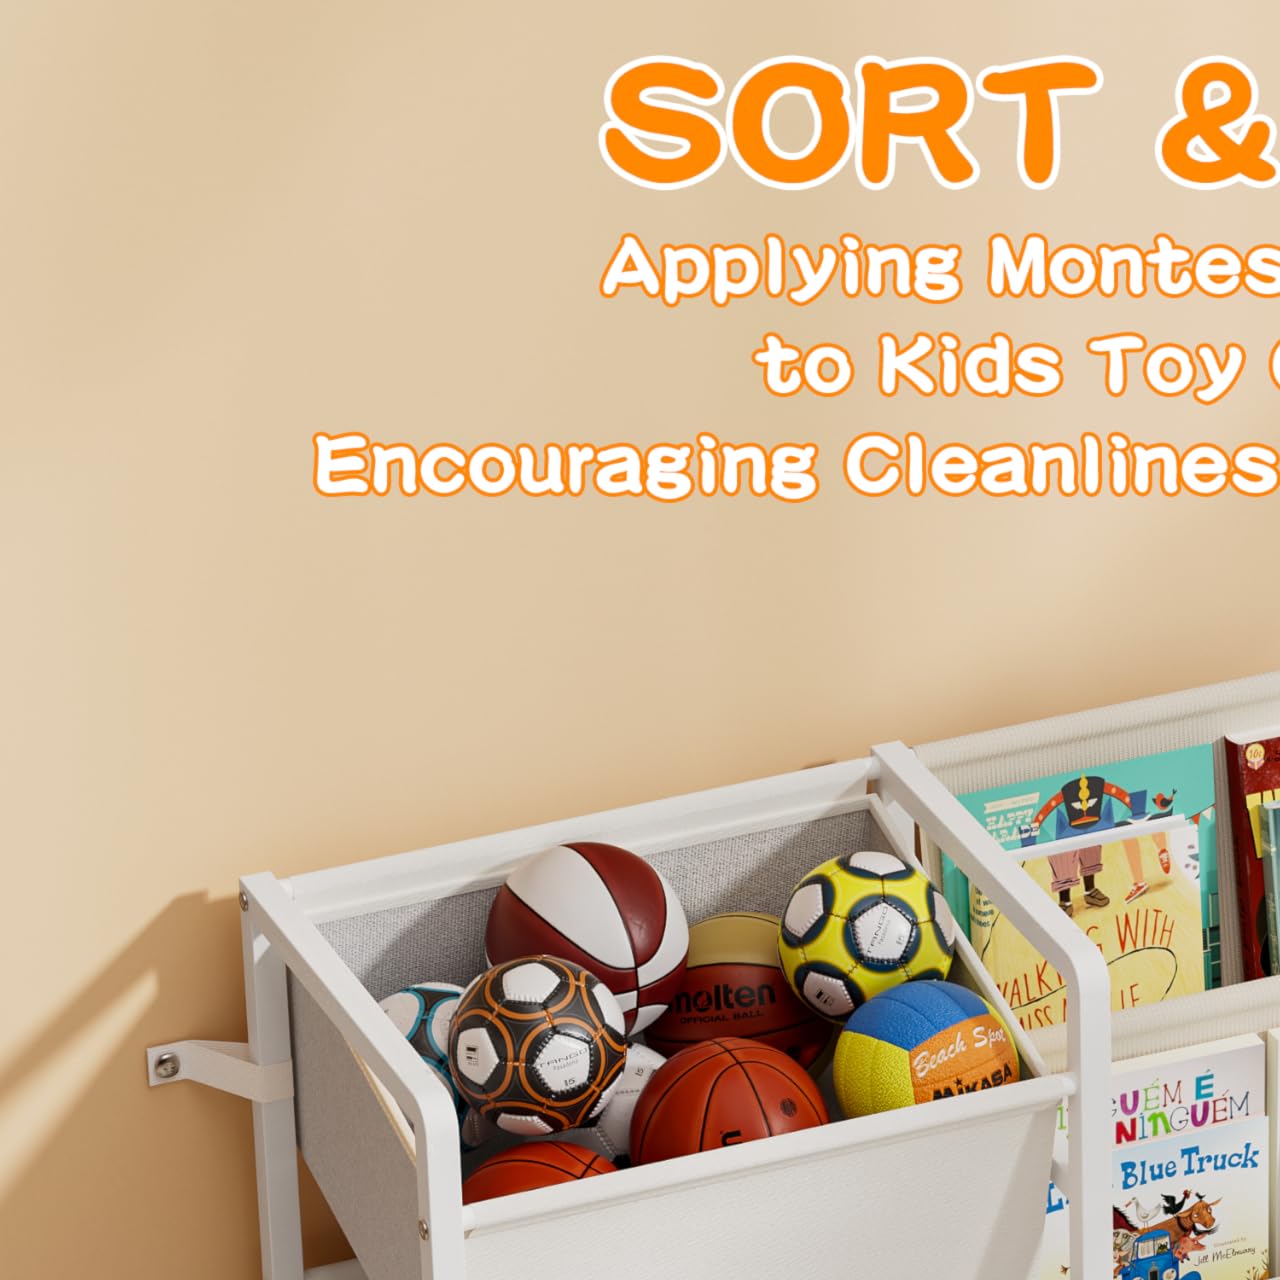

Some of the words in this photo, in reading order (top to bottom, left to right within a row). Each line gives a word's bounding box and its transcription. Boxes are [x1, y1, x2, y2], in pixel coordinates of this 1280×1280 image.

[1116, 908, 1175, 953] WITH
[681, 1014, 729, 1024] OFFICIAL
[733, 1009, 765, 1020] BALL
[913, 1031, 967, 1078] Beach
[1120, 1159, 1177, 1190] Blue
[1180, 1142, 1260, 1177] Truck
